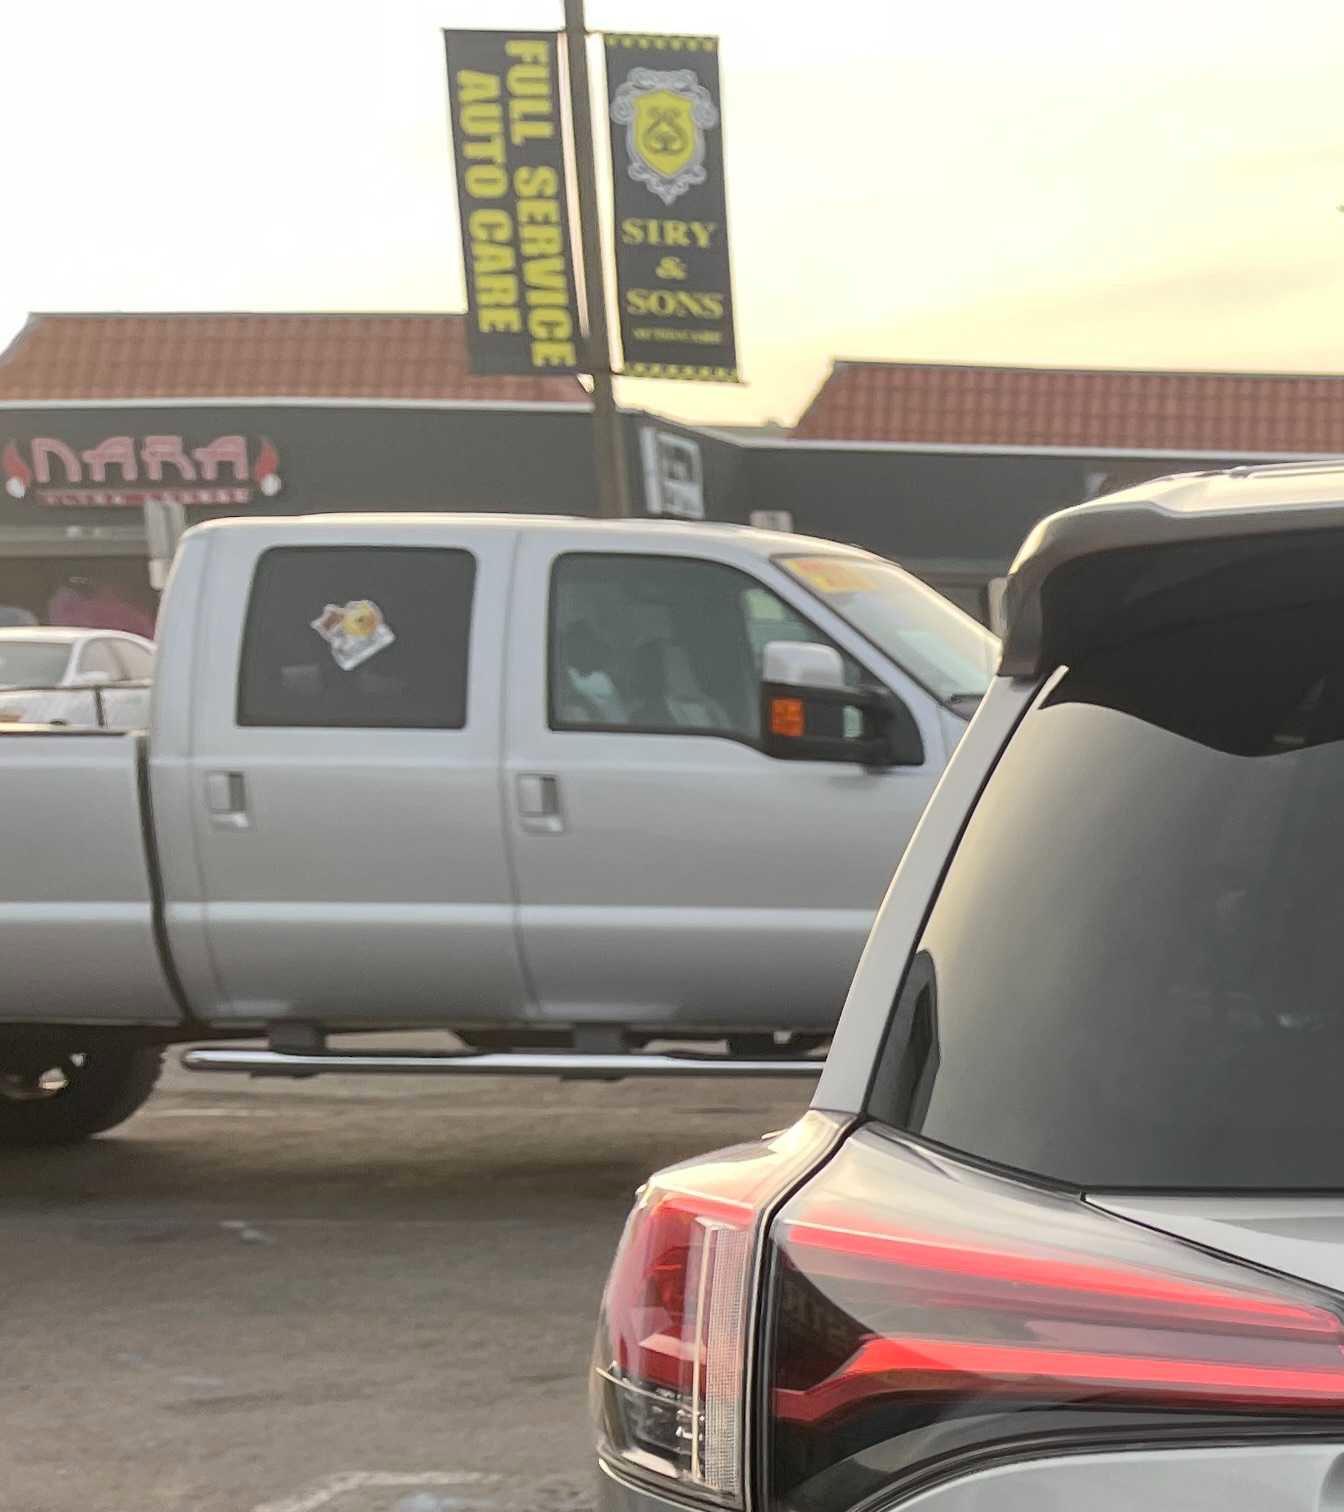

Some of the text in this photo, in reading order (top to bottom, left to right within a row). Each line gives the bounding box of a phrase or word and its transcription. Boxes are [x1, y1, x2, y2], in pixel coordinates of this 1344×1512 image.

[456, 69, 521, 333] AUTO CARE
[505, 40, 576, 367] FULL SERVICE
[621, 217, 718, 248] SIRY
[655, 256, 688, 280] &
[625, 287, 723, 320] SONS
